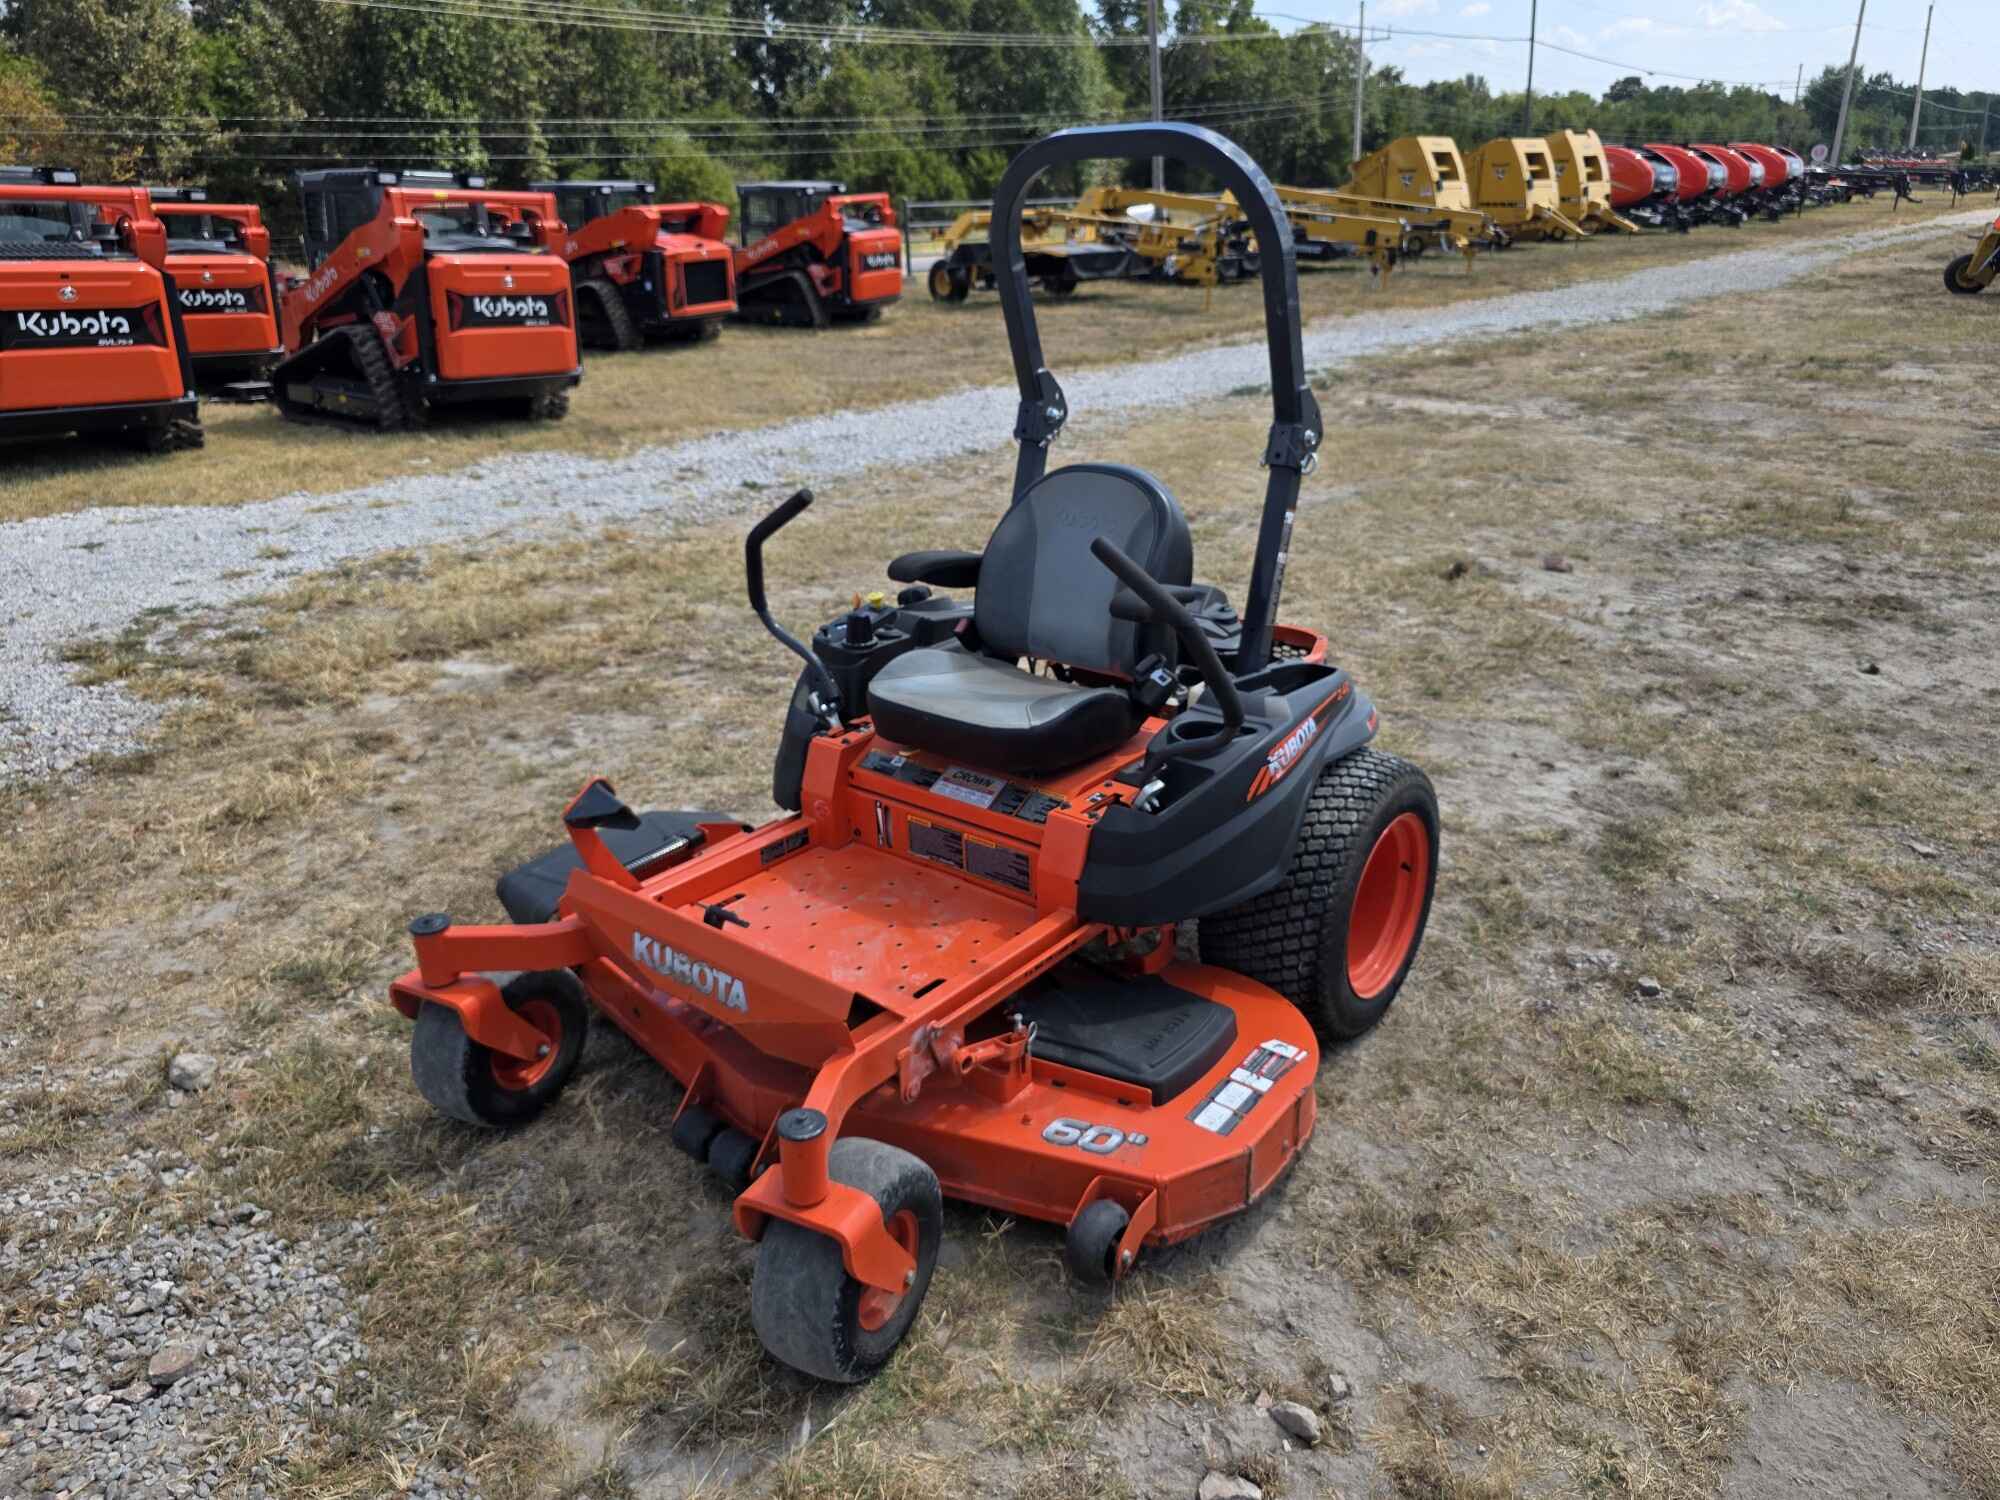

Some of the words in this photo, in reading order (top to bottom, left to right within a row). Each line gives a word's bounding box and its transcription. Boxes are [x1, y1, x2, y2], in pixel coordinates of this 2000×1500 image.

[178, 289, 246, 307] Kubota
[472, 296, 548, 318] Kubota
[17, 310, 130, 336] Kubota
[1267, 716, 1318, 775] KUBOTA
[952, 770, 994, 788] CROWN
[631, 928, 750, 1014] KUBOTA
